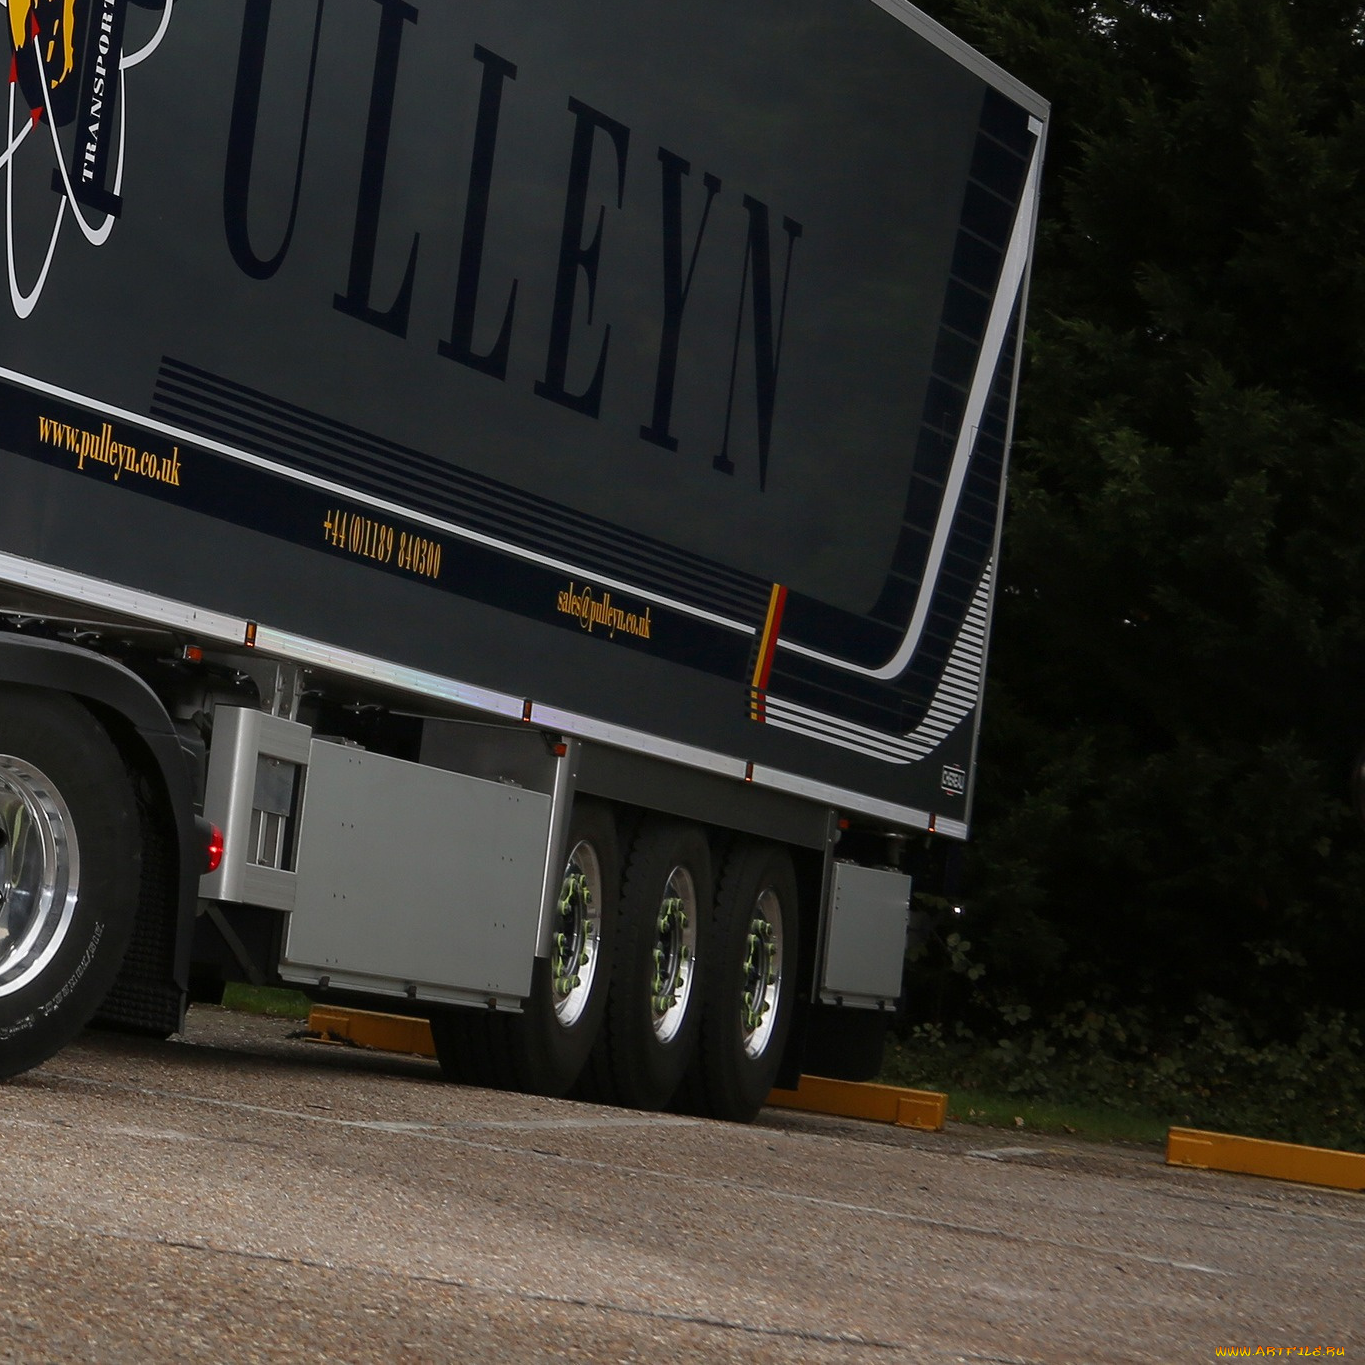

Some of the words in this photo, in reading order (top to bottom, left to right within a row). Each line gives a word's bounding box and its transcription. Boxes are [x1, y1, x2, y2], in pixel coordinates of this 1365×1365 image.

[38, 415, 181, 486] www.pulleyn.co.uk
[398, 531, 441, 579] 840300
[557, 582, 651, 639] sales@pulleyn.co.uk
